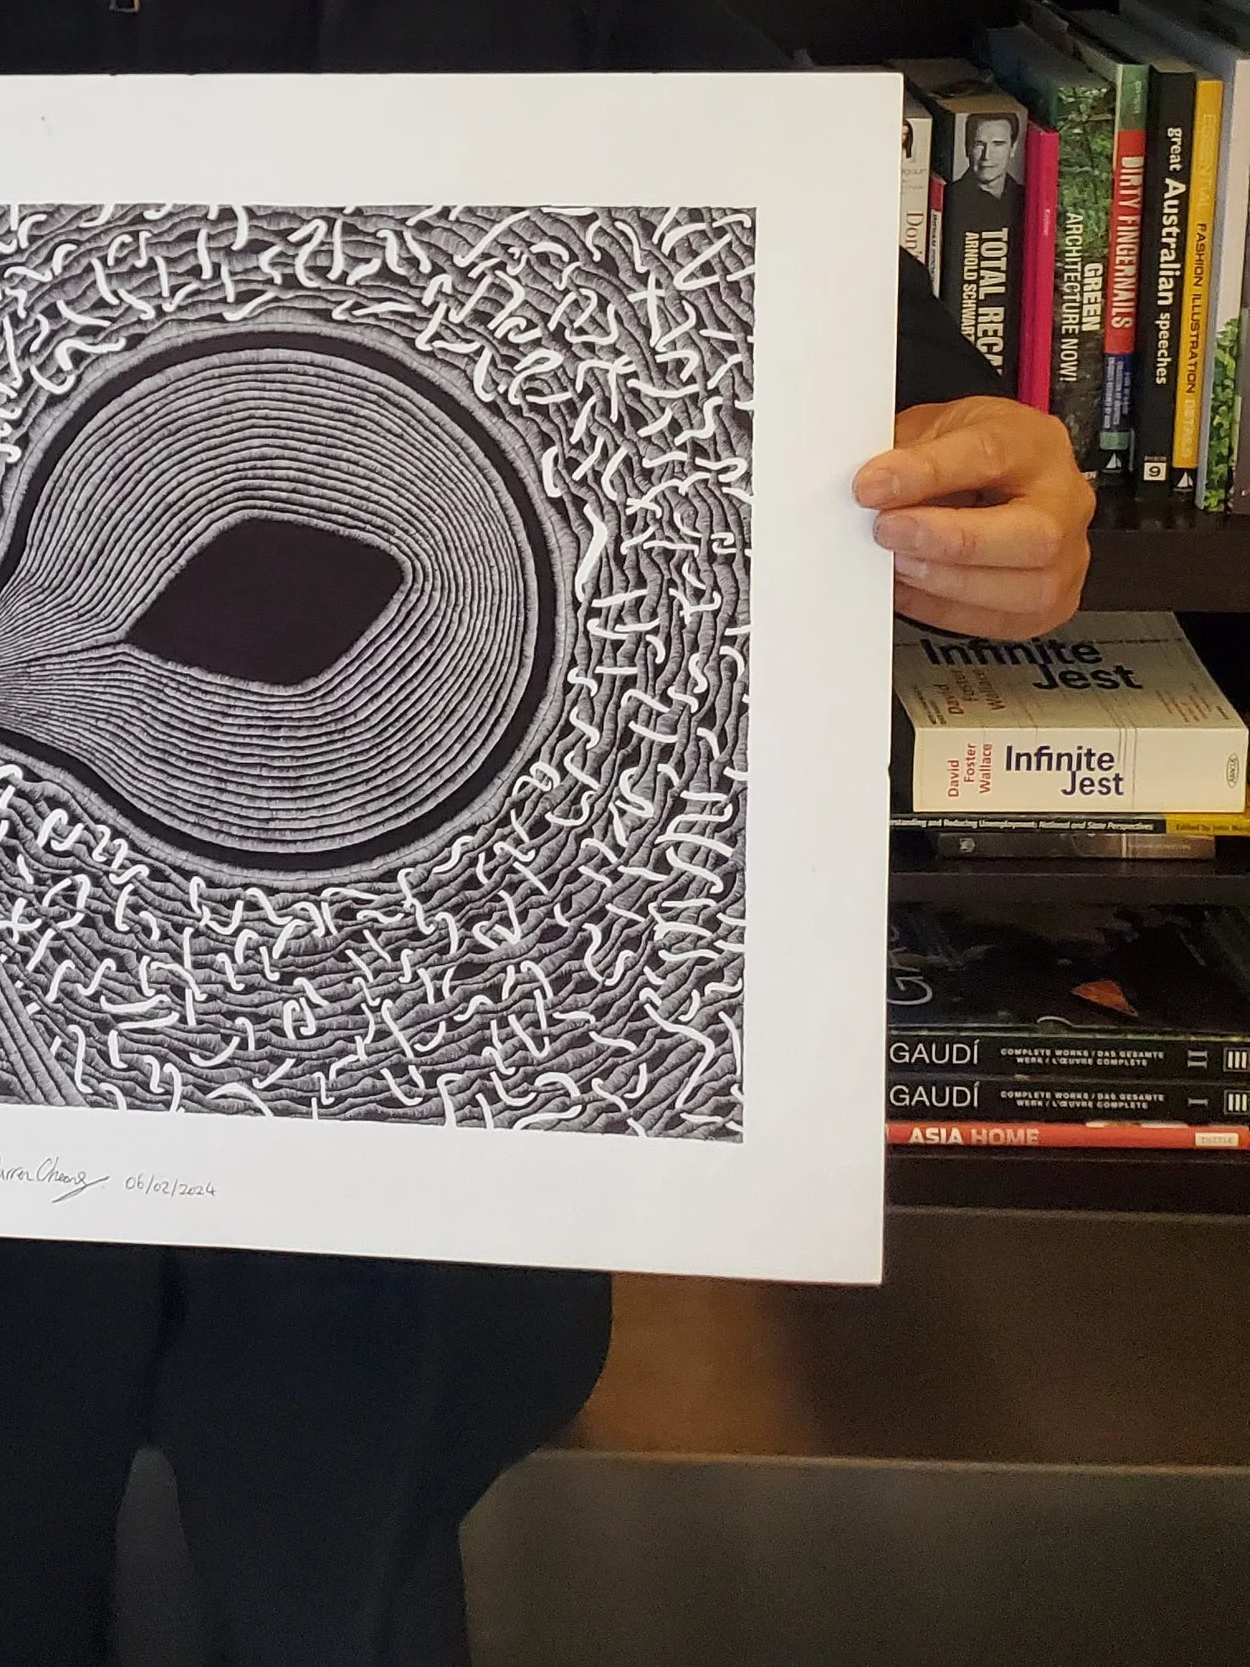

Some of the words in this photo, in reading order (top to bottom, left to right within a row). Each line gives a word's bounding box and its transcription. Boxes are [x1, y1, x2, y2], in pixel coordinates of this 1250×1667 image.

[1167, 126, 1183, 172] great
[1117, 156, 1145, 206] DIRTY
[1156, 177, 1187, 307] Australian
[1060, 212, 1084, 337] ARCHITECTURE
[1110, 210, 1141, 329] FINGERNAILS
[1081, 263, 1104, 332] GREEN
[1059, 339, 1080, 382] NOW!
[1154, 313, 1172, 385] speeches
[1005, 745, 1114, 772] Infinite
[1061, 771, 1124, 796] Jest
[889, 1039, 981, 1064] GAUDÍ
[889, 1081, 981, 1107] GAUDÍ
[909, 1127, 963, 1145] ASIA
[970, 1128, 1040, 1145] HOME
[125, 1174, 218, 1197] 06/02/2024
